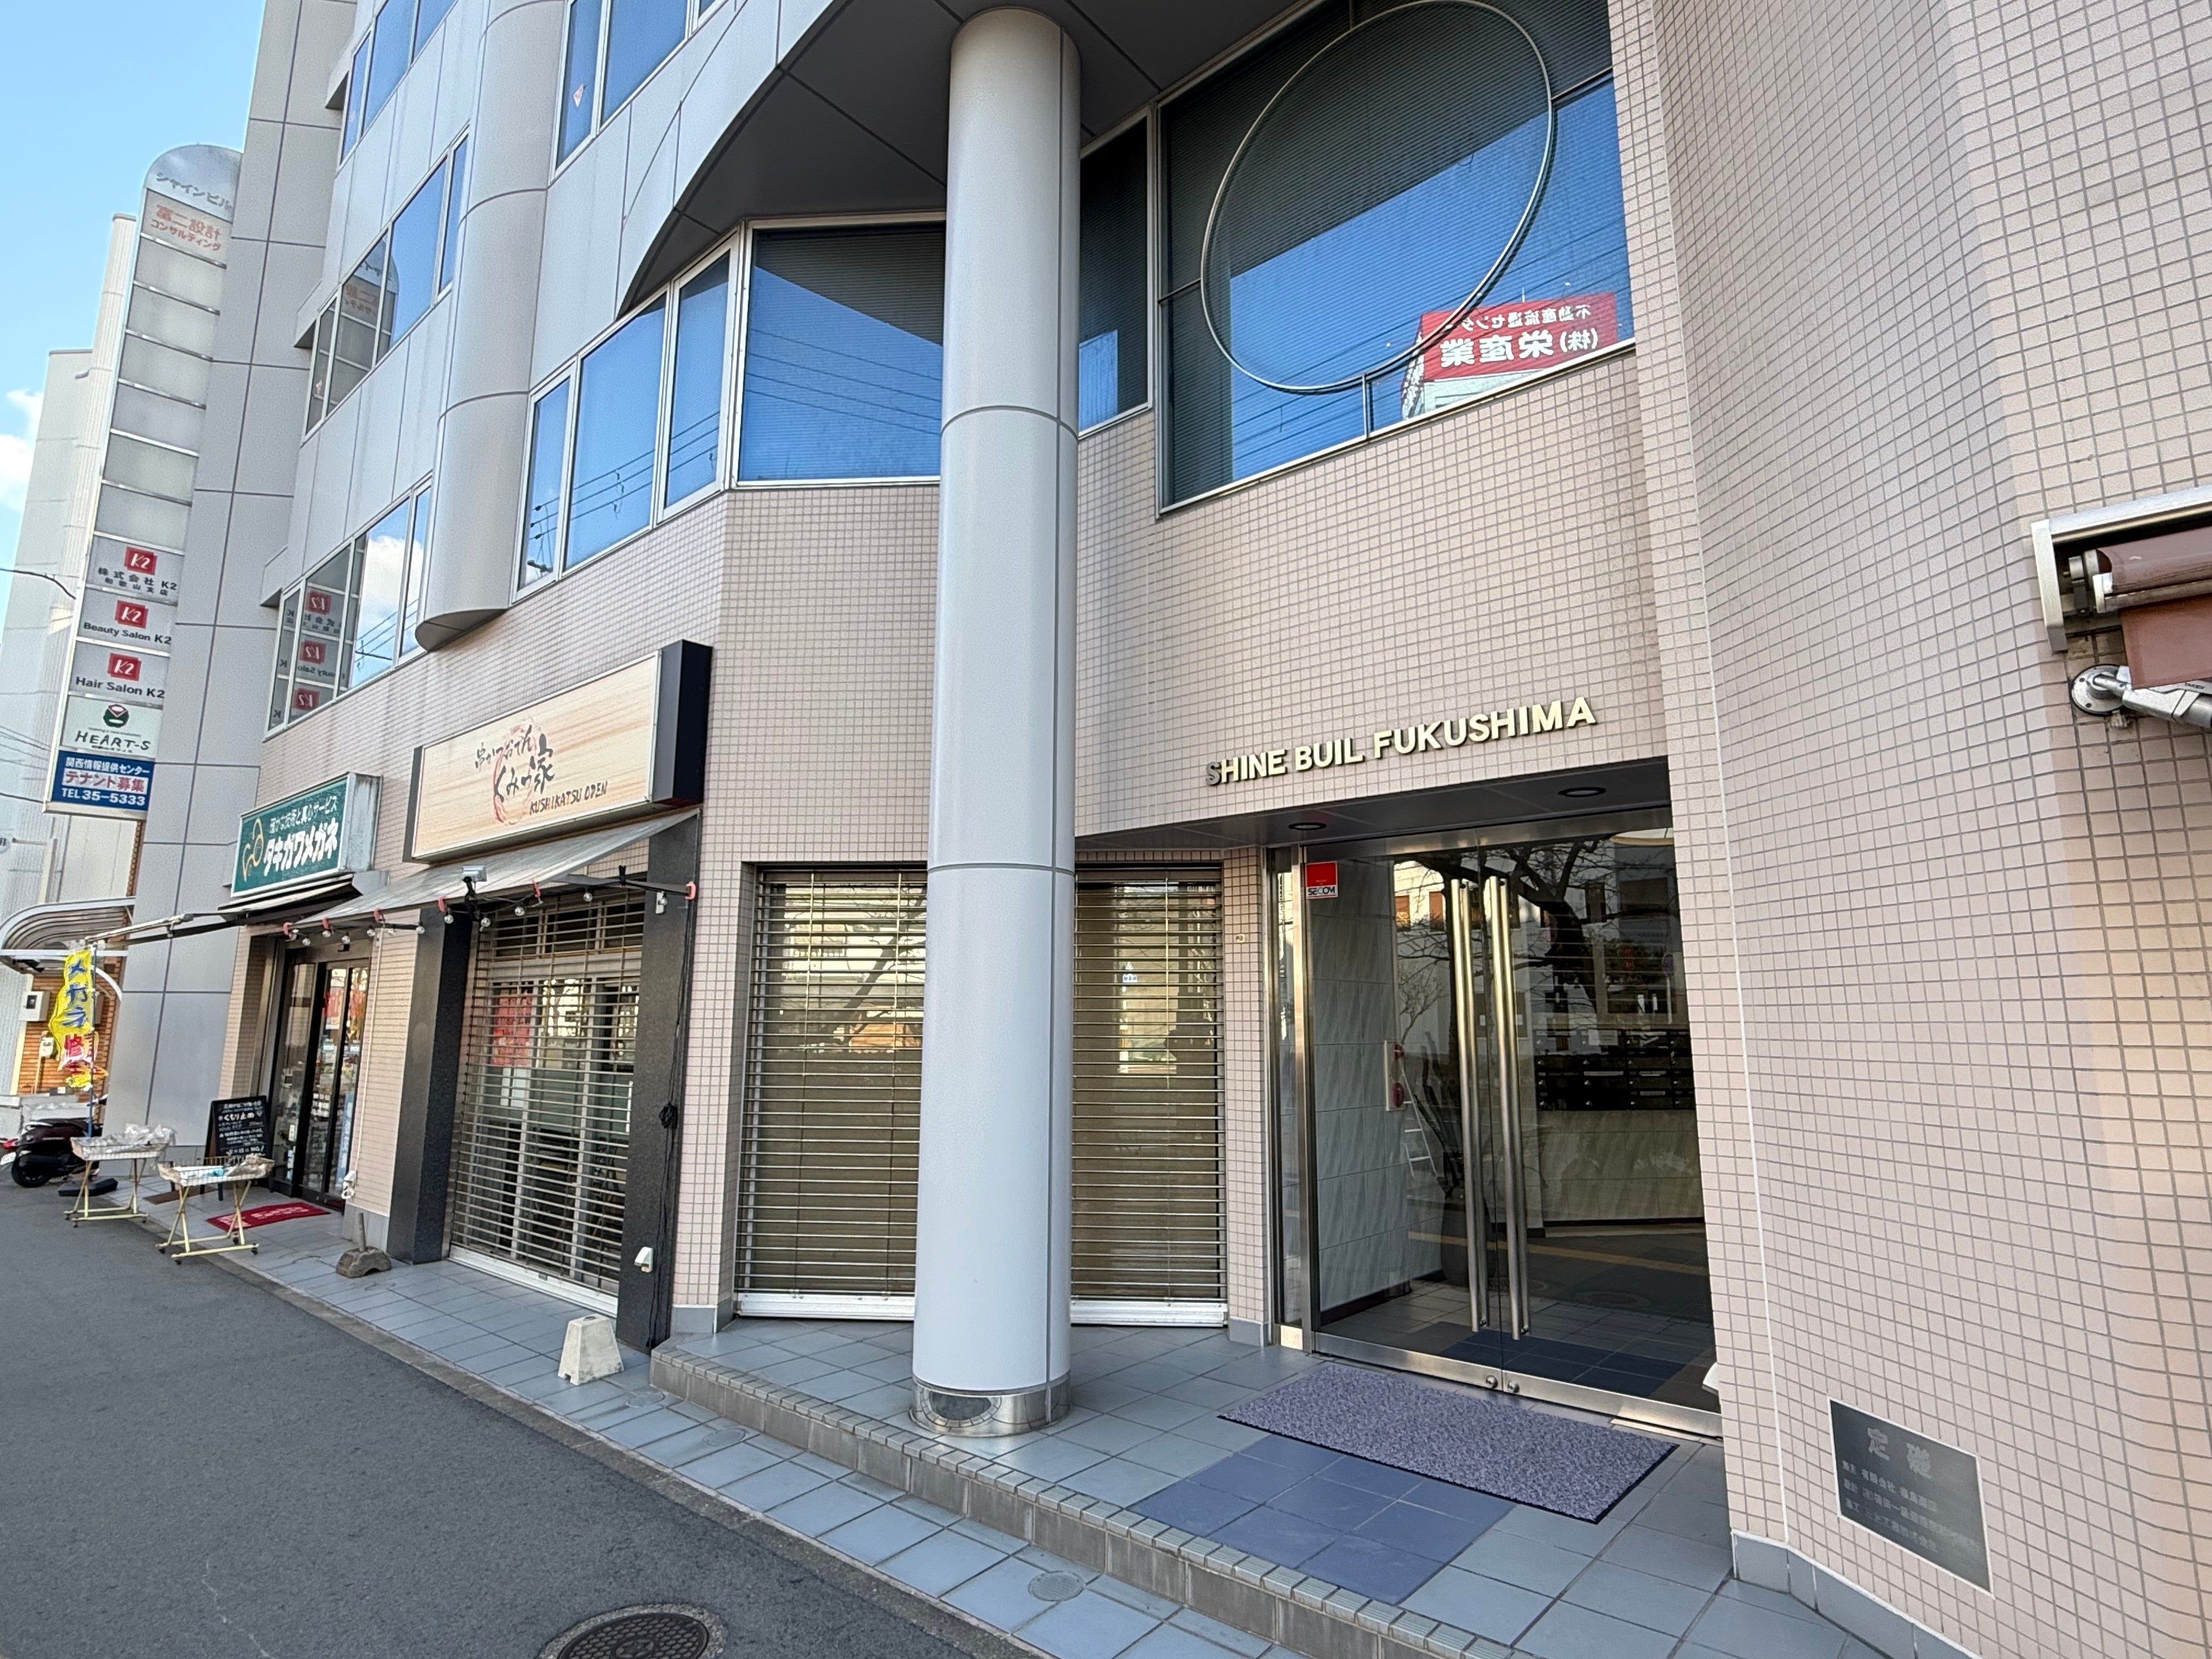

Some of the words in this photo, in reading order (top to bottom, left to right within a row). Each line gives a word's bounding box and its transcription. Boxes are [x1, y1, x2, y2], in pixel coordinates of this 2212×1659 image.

[151, 219, 221, 250] コンサルティング
[130, 553, 150, 569] K2
[162, 580, 177, 590] K2
[121, 607, 141, 622] K2
[83, 622, 119, 636] Beauty
[122, 630, 151, 641] Salon
[154, 634, 172, 645] K2
[114, 660, 134, 675] K2
[75, 677, 103, 689] Hair
[107, 682, 142, 695] Salon
[146, 688, 166, 699] K2
[75, 731, 151, 750] HEART-S
[1204, 748, 1287, 786] SHINE
[1294, 737, 1365, 772] BUIL
[1373, 696, 1598, 759] FUKUSHIMA
[66, 771, 145, 792] テナント募集
[62, 788, 80, 799] TEL
[82, 789, 146, 806] 35-5333
[529, 788, 582, 816] KUSHIKATSU
[584, 780, 608, 801] OPEN
[1308, 886, 1335, 896] SECOM
